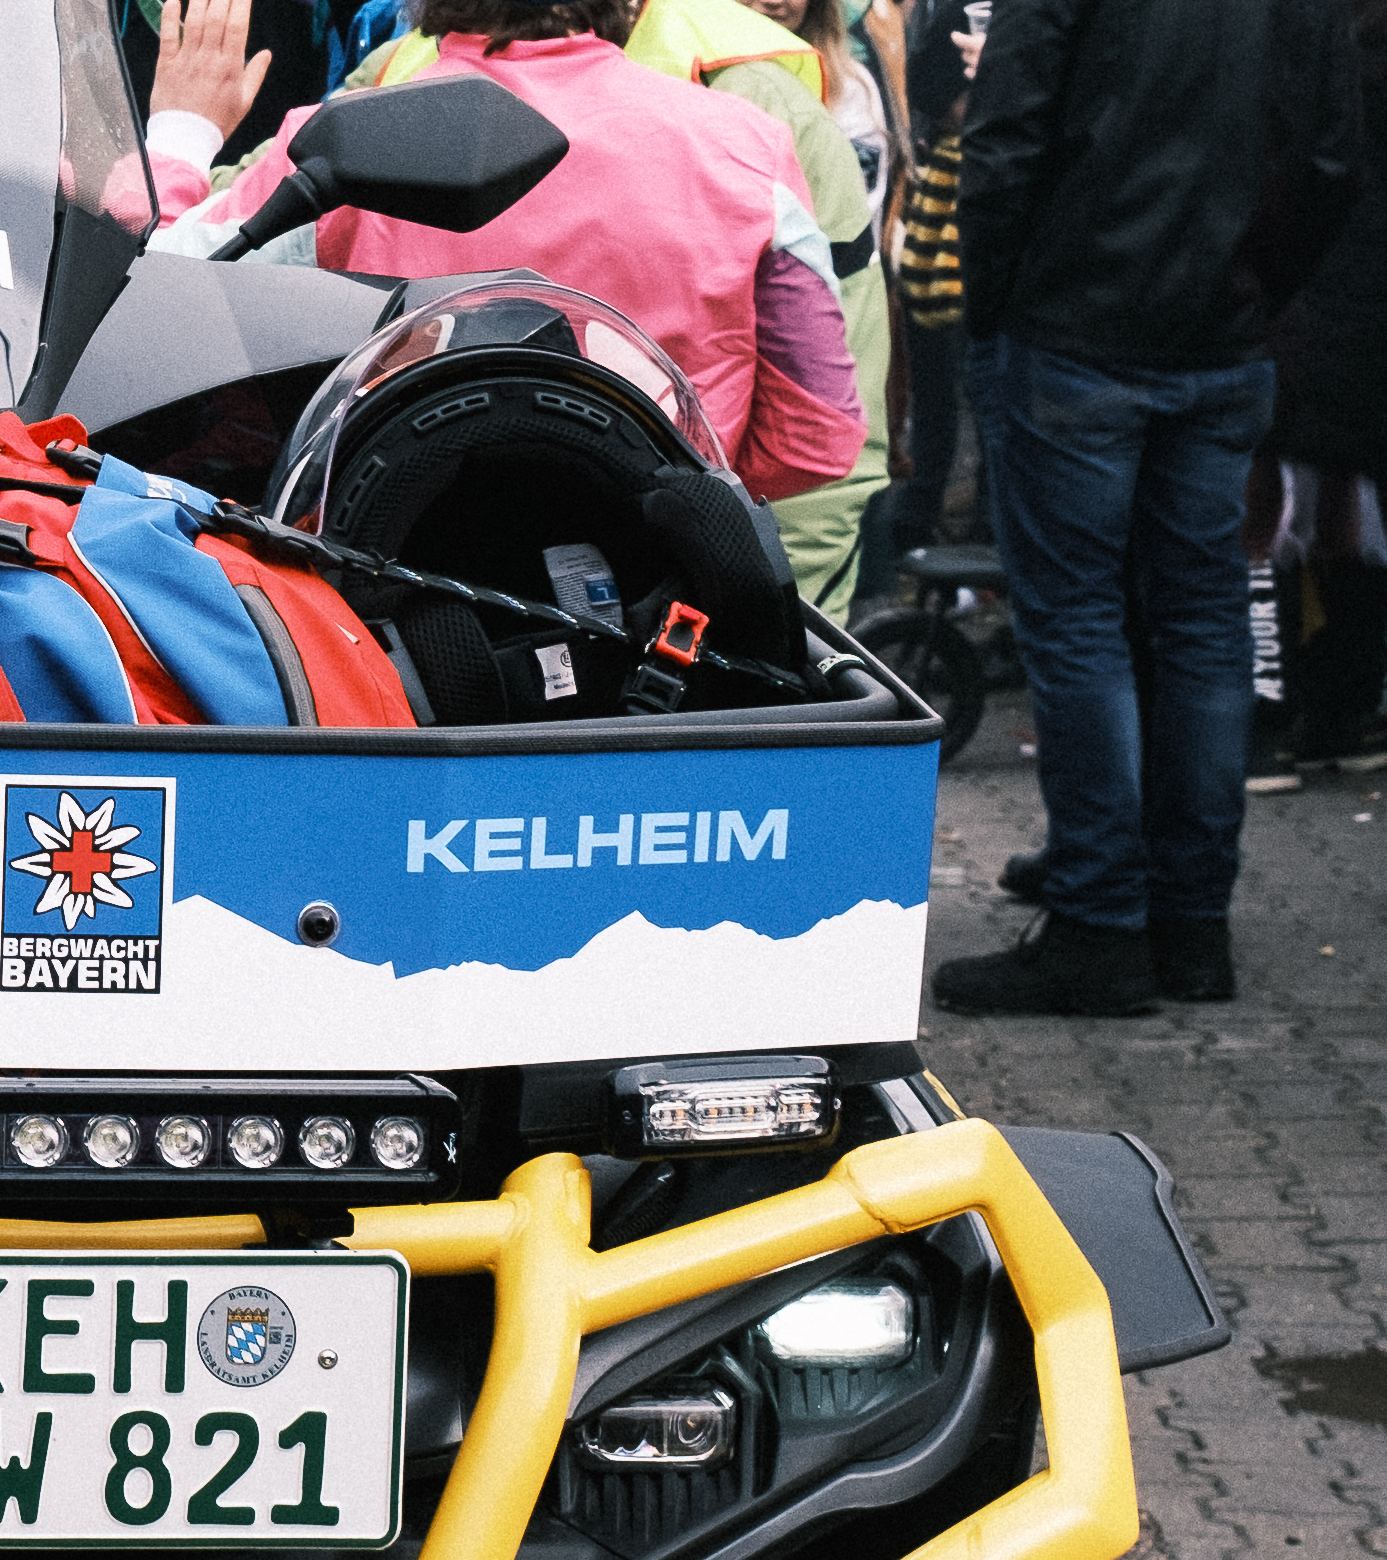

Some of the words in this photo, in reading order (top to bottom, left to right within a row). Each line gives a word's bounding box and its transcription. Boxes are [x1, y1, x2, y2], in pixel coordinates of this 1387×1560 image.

[406, 808, 790, 874] KELHEIM
[2, 937, 160, 959] BERGWACHT
[1, 958, 157, 990] BAYERN
[228, 1288, 270, 1301] BAYERN
[103, 1409, 341, 1527] 821
